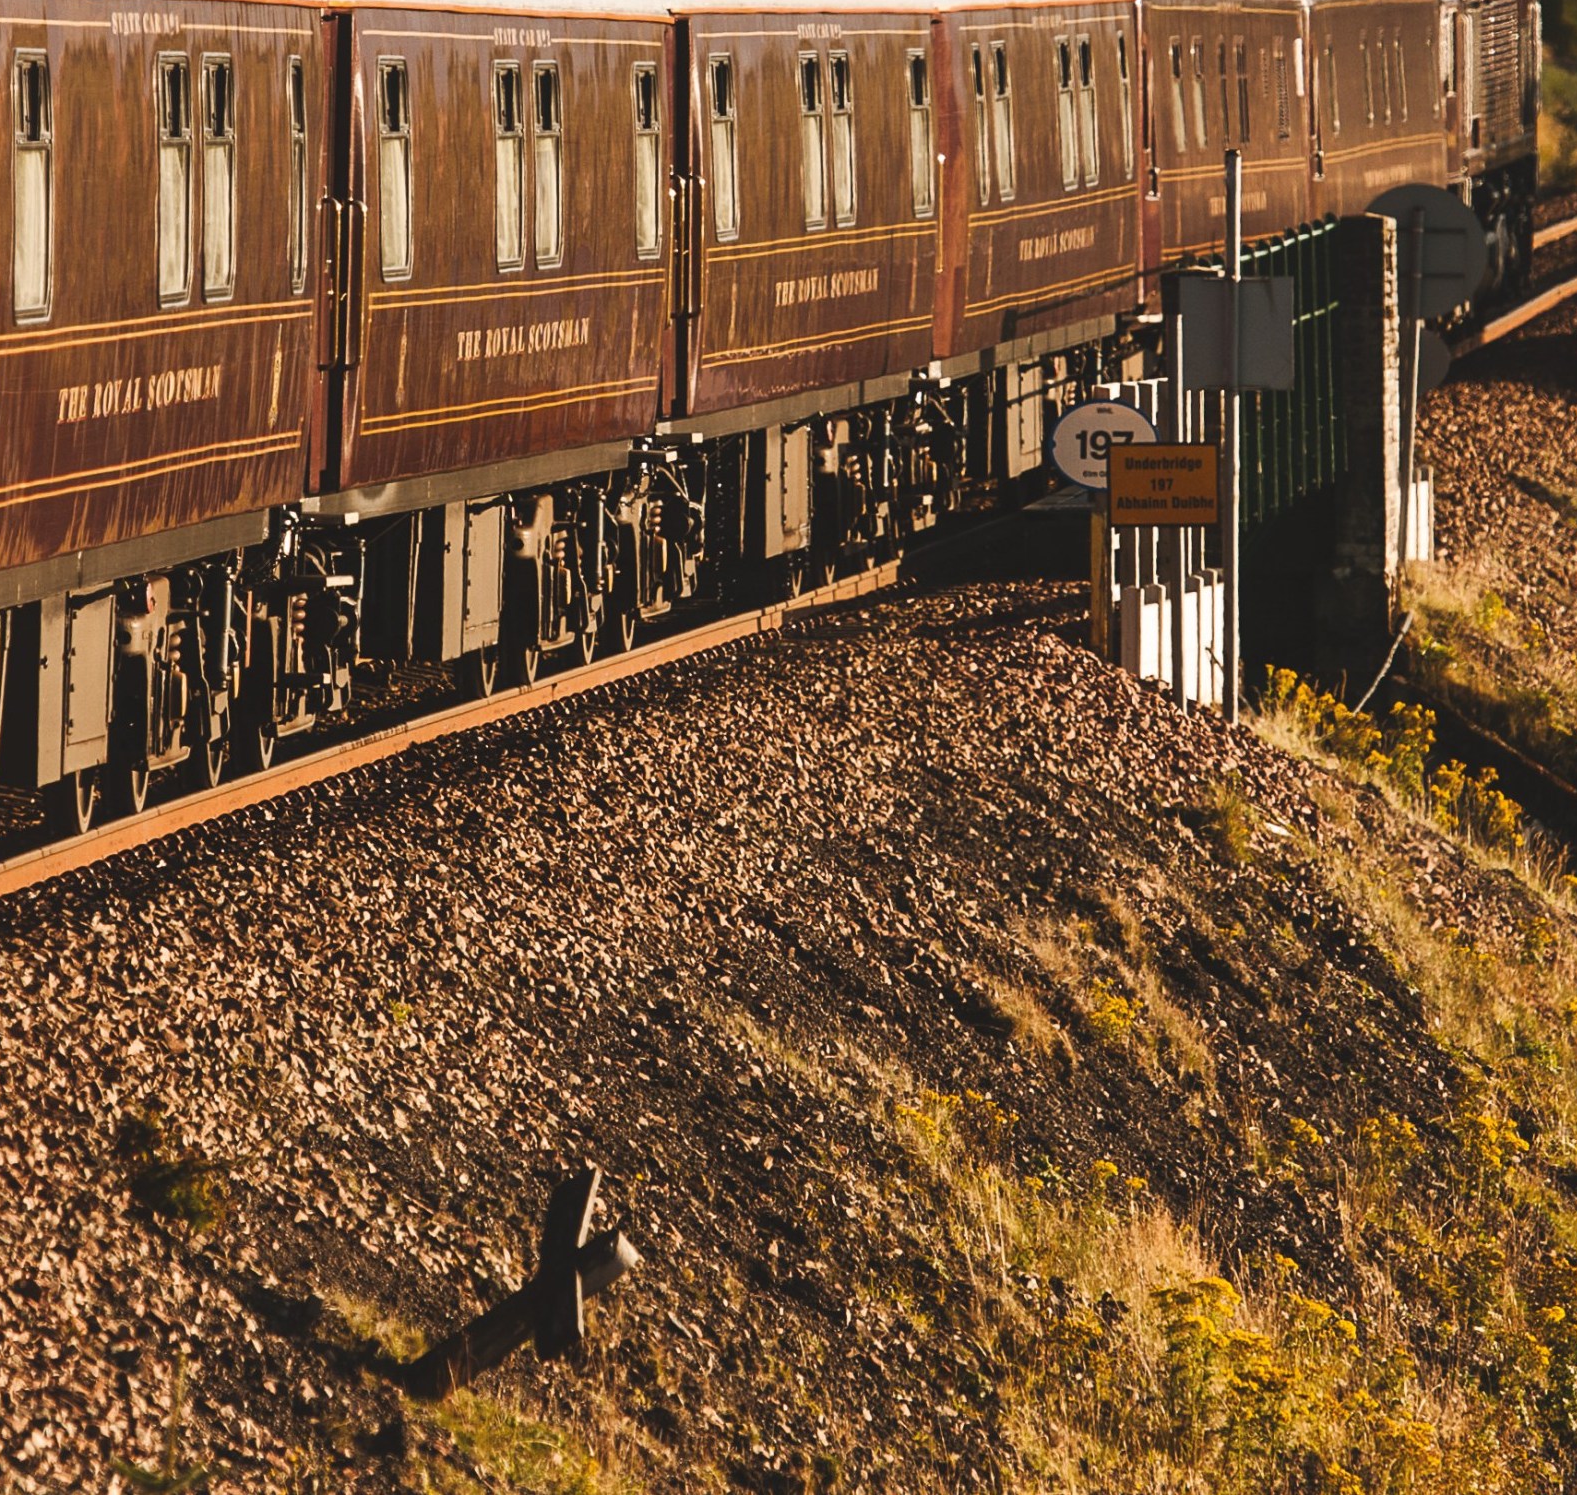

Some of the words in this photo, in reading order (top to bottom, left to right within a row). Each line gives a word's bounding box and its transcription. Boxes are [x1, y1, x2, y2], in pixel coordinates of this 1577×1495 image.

[111, 11, 141, 36] STATE
[142, 12, 161, 34] CAR
[493, 27, 518, 46] STATE
[519, 28, 535, 47] CAR
[775, 280, 795, 307] THE
[797, 275, 828, 303] ROYAL
[830, 267, 879, 299] SCOTSMAN
[456, 330, 481, 361] THE
[484, 326, 525, 358] ROYAL
[528, 317, 590, 354] SCOTSMAN
[56, 384, 88, 424] THE
[92, 376, 142, 419] ROYAL
[146, 362, 223, 411] SCOTSMAN
[1125, 456, 1202, 472] Underbridge
[1150, 478, 1174, 491] 197
[1117, 496, 1168, 509] Abhainn
